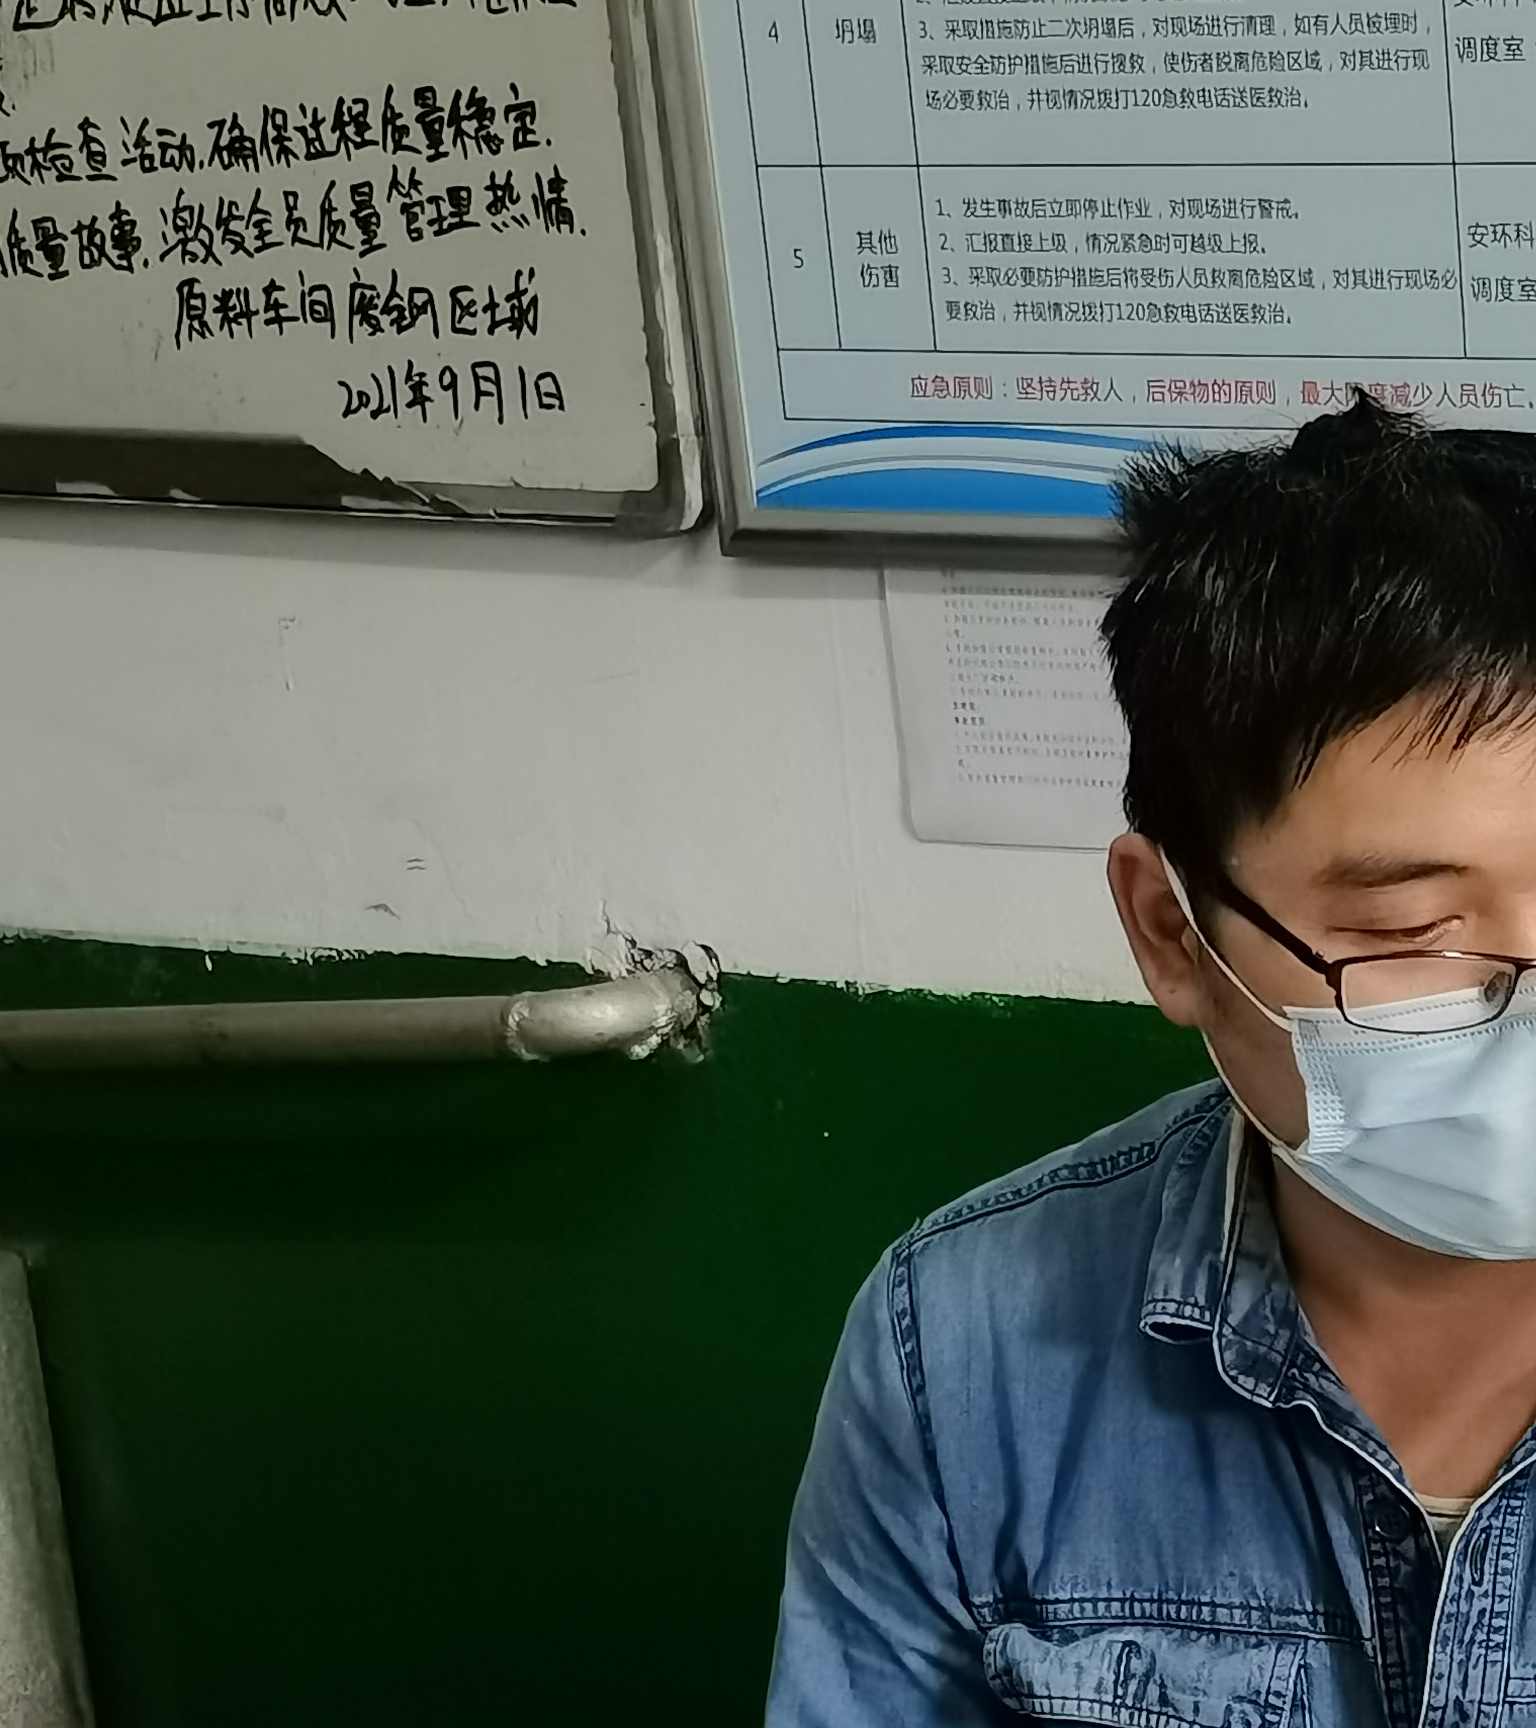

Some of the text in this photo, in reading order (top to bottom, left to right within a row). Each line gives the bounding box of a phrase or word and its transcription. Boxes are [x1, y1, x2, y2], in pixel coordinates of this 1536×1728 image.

[767, 22, 780, 44] 4
[856, 230, 900, 256] 其他
[793, 248, 805, 269] 5
[860, 263, 901, 289] 伤害
[337, 360, 566, 425] 2021年9月1日
